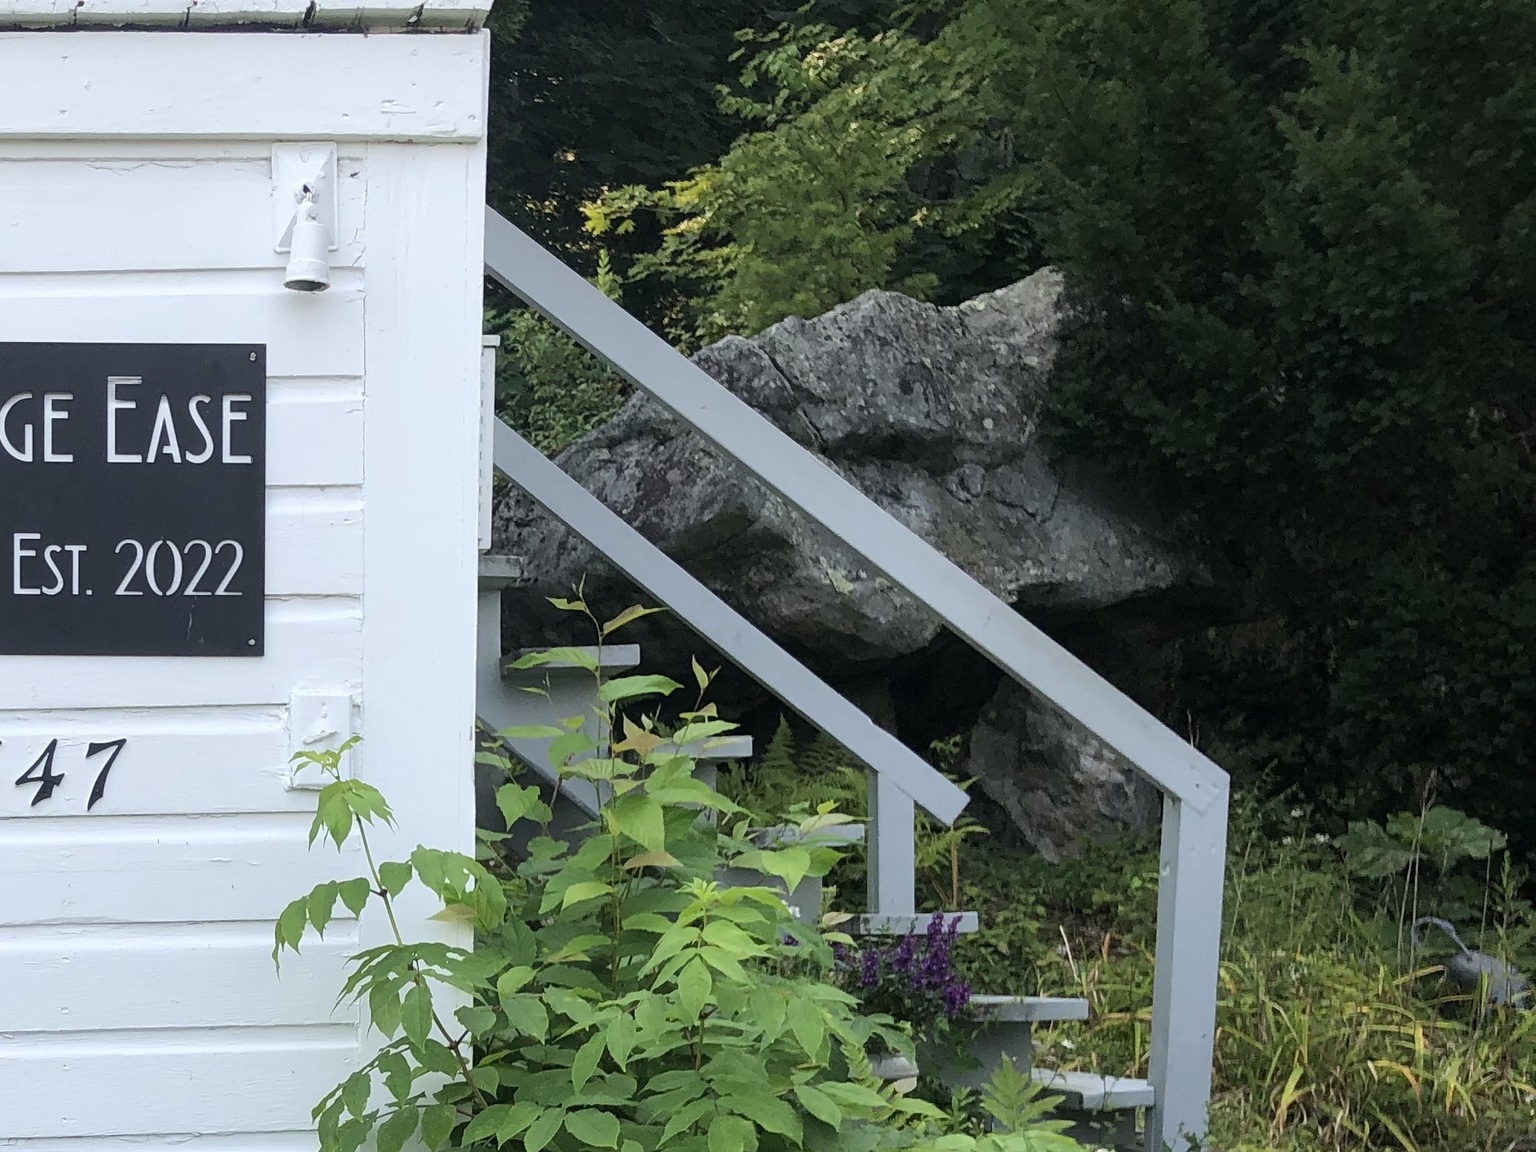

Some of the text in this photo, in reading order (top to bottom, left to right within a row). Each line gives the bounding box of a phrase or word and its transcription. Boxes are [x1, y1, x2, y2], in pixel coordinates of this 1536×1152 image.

[106, 375, 254, 464] EASE
[12, 532, 244, 597] EST. 2022
